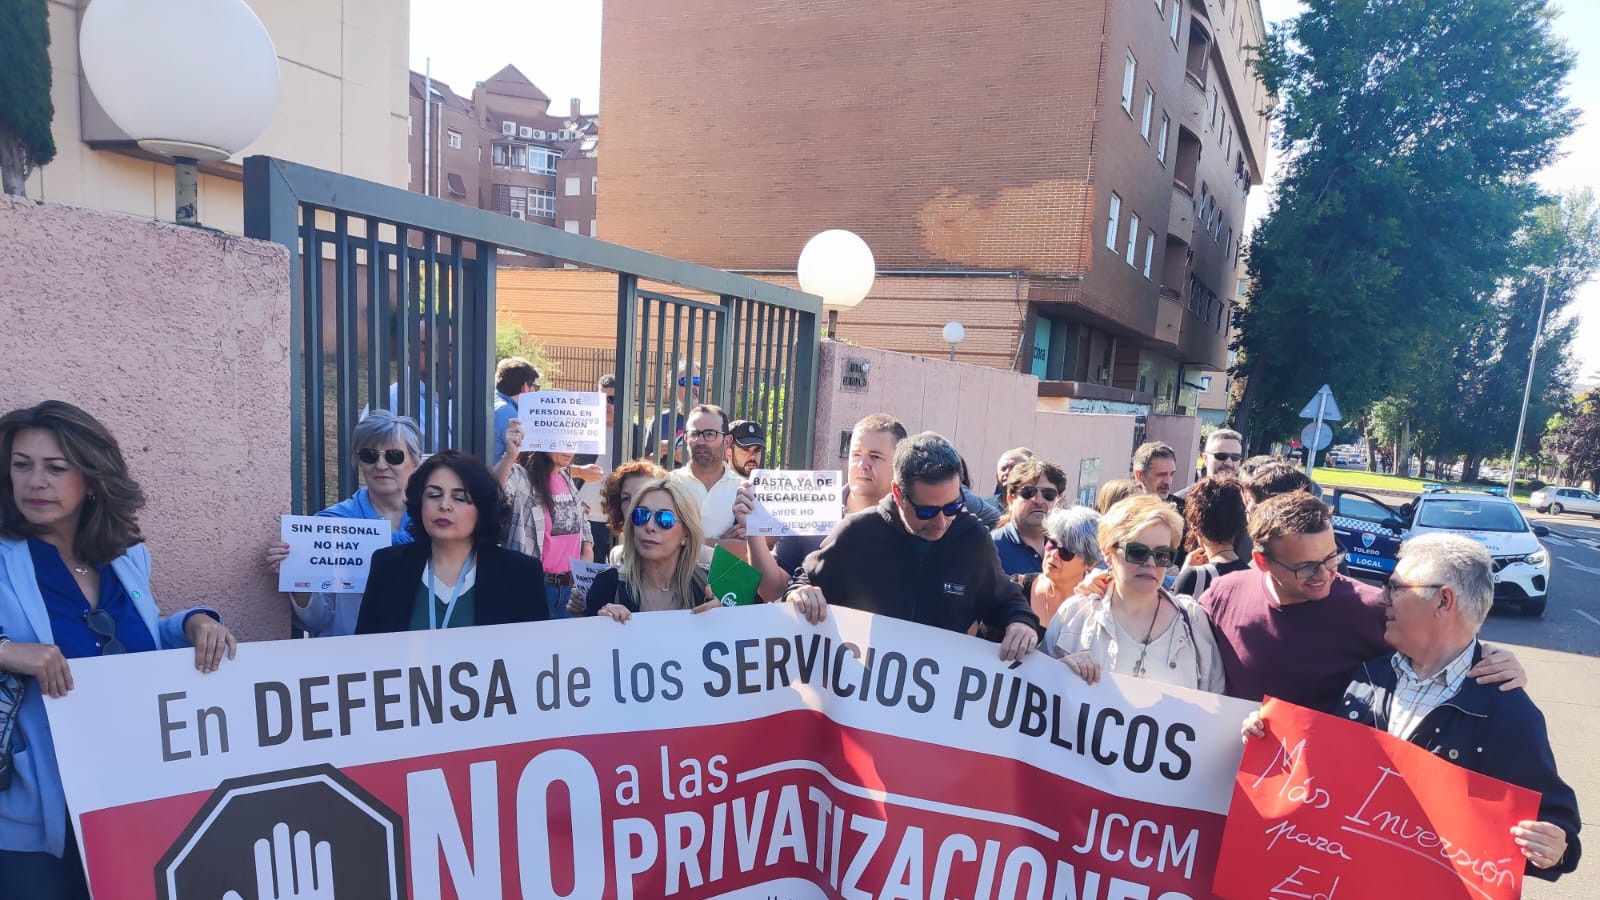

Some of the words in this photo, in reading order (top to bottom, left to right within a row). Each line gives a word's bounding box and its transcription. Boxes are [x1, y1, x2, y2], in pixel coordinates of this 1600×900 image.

[529, 408, 577, 416] PERSONAL
[753, 477, 793, 487] BASTA
[797, 477, 813, 487] YA
[816, 478, 833, 487] DE
[753, 492, 836, 502] RECARIEDAD
[291, 523, 313, 533] SIN
[316, 524, 380, 536] PERSONAL
[313, 540, 332, 550] NO
[336, 541, 360, 550] HAY
[1352, 546, 1380, 556] TOLEDO
[310, 556, 363, 567] CALIDAD
[1356, 557, 1382, 568] LOCAL
[157, 692, 230, 763] En
[254, 659, 517, 749] DEFENSA
[535, 654, 592, 713] de
[611, 648, 684, 704] los
[703, 634, 939, 714] SERVICIOS
[953, 660, 1196, 781] PÚBLICOS
[615, 765, 642, 805] a
[660, 745, 730, 800] las
[1252, 737, 1330, 809] Más
[1344, 766, 1516, 889] Inversión
[406, 748, 606, 900] NO
[1072, 808, 1200, 879] JCCM
[1265, 820, 1352, 860] para
